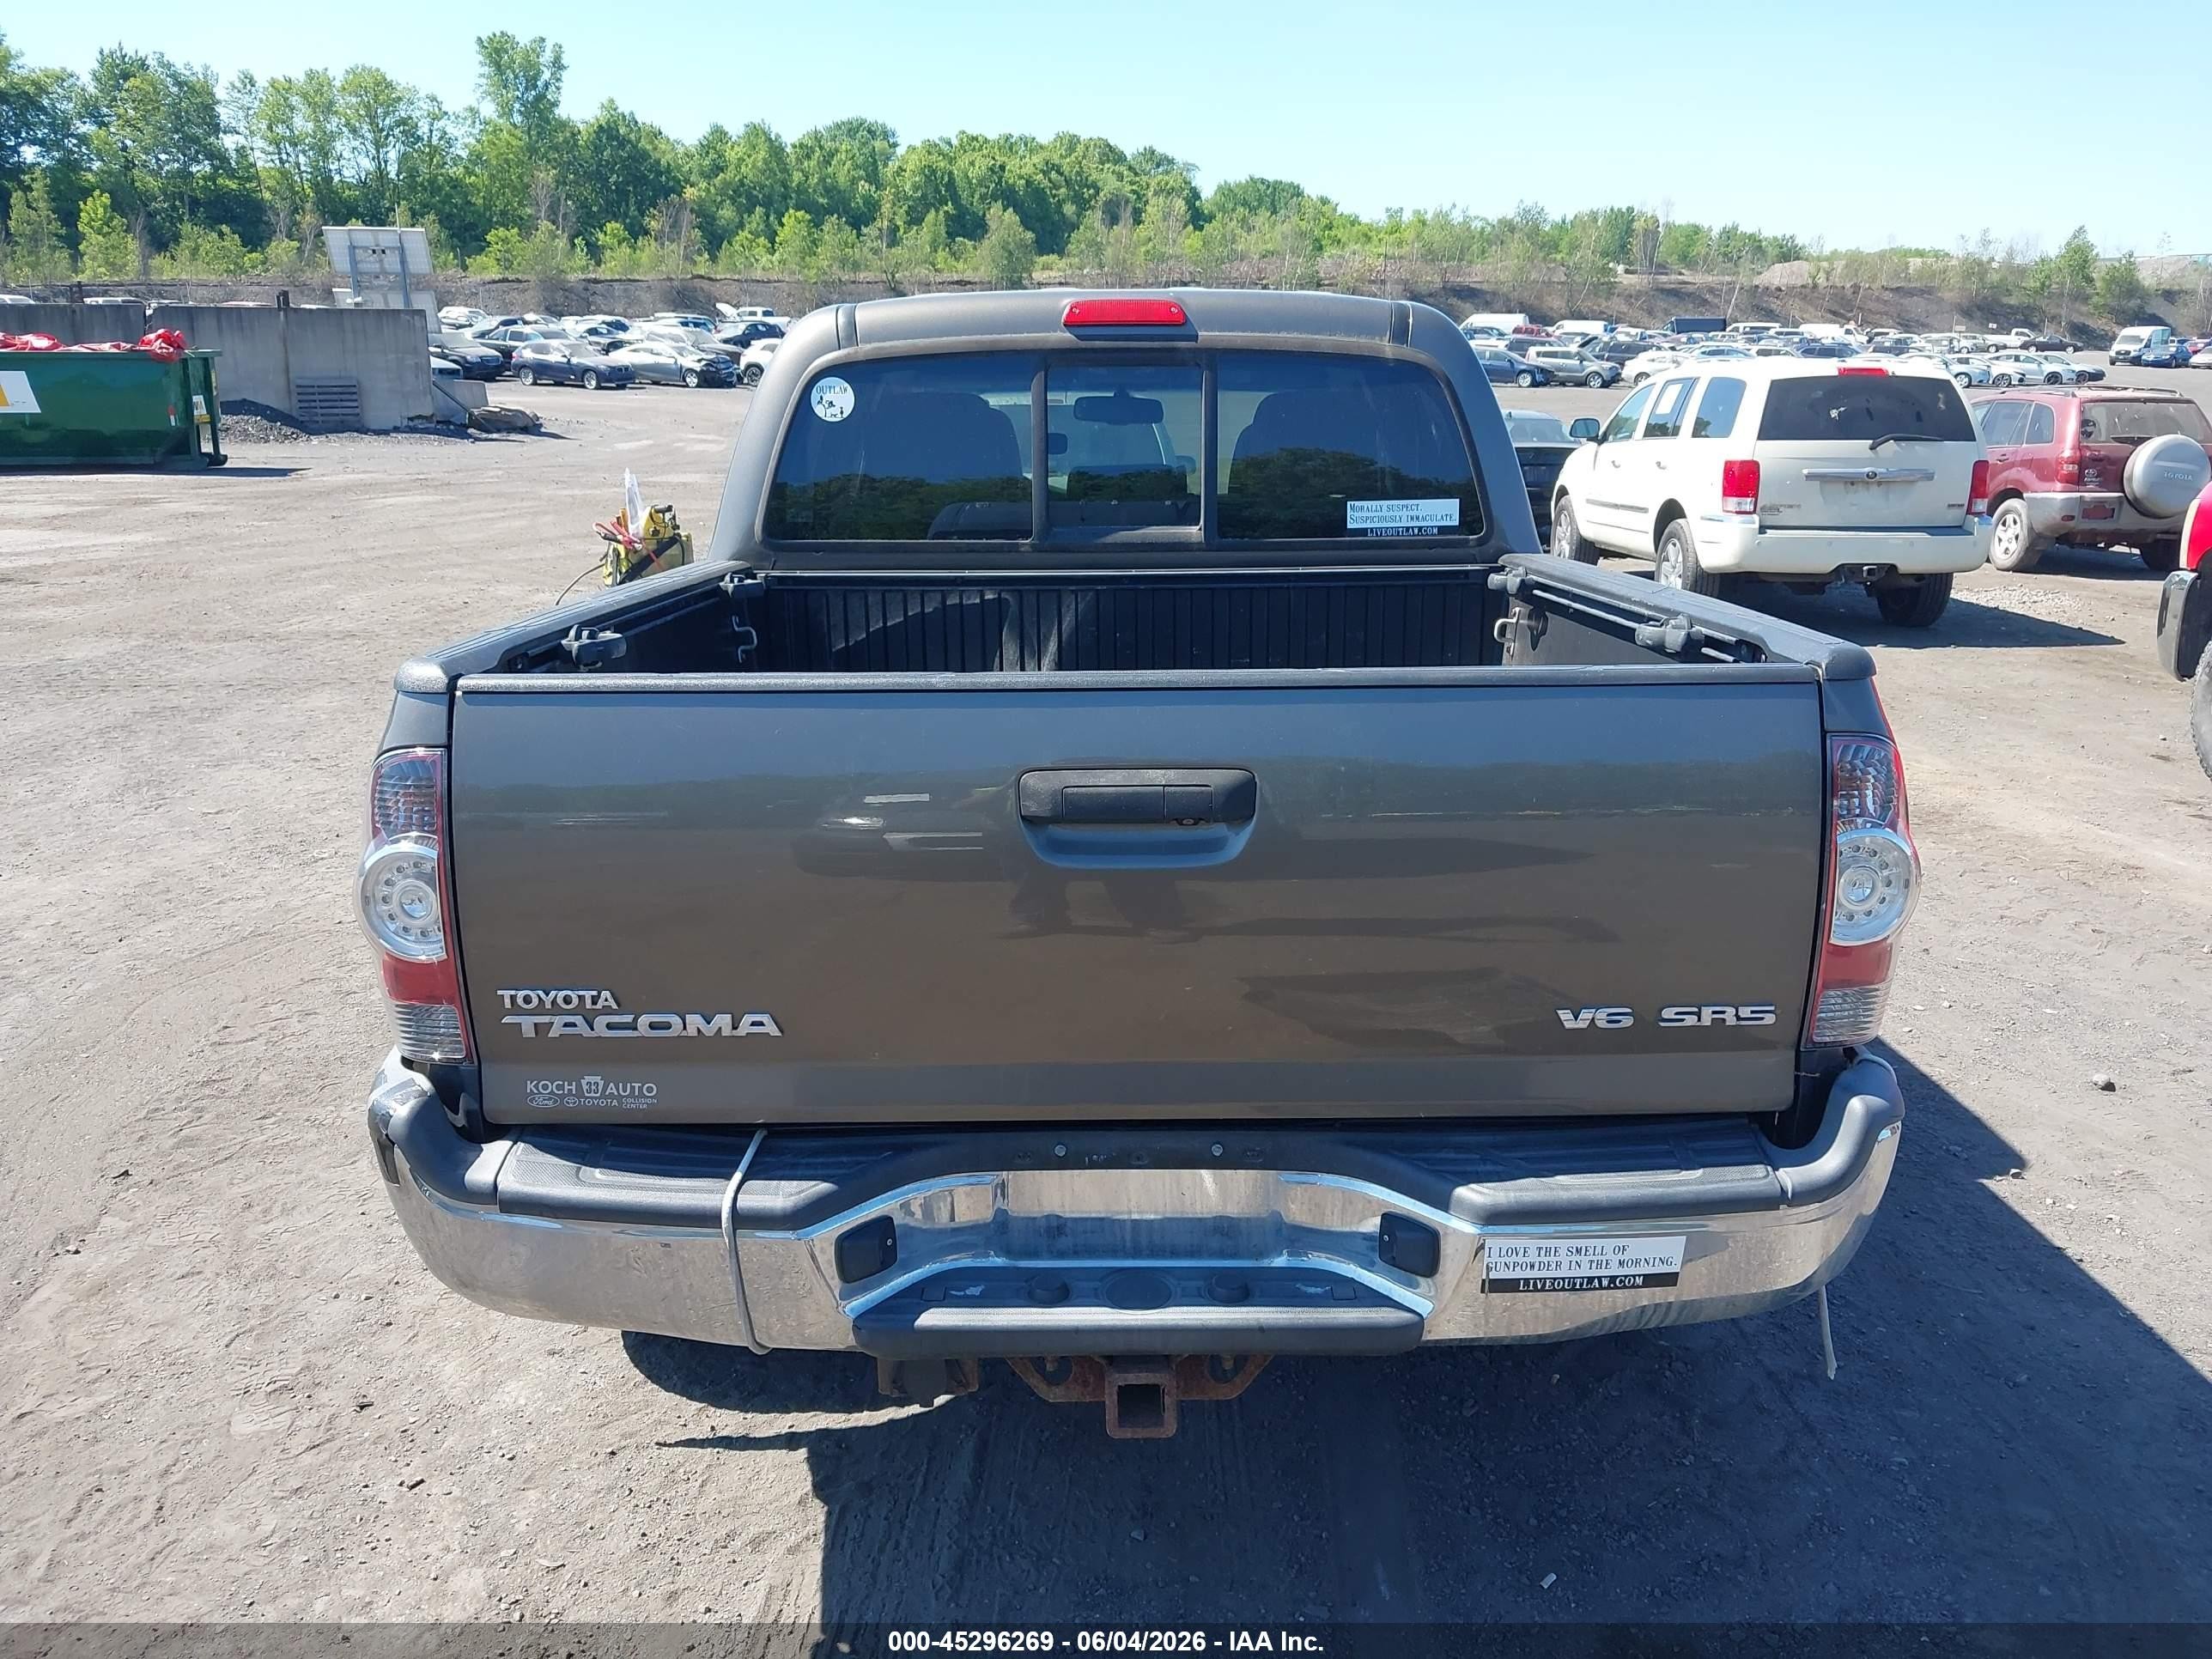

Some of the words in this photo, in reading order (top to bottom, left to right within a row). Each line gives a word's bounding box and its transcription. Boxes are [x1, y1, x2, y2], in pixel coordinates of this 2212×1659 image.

[816, 384, 848, 395] OUTLAW
[2163, 471, 2193, 481] TOYOTA
[1367, 526, 1438, 537] LIVEOUTLAW.COM
[496, 990, 618, 1010] TOYOTA
[1555, 1006, 1635, 1030] V6
[1657, 1005, 1777, 1027] SR5
[501, 1013, 783, 1038] TACOMA
[526, 1080, 576, 1094] KOCH
[586, 1081, 600, 1095] 33
[605, 1083, 657, 1097] AUTO
[580, 1098, 619, 1107] TOYOTA
[1487, 1247, 1493, 1258] I
[1498, 1247, 1530, 1258] LOVE
[1536, 1246, 1561, 1257] THE
[1565, 1245, 1608, 1257] SMELL
[1613, 1244, 1630, 1255] OF
[1486, 1261, 1563, 1273] GUNPOWDER
[1568, 1260, 1582, 1271] IN
[1588, 1259, 1613, 1270] THE
[1617, 1256, 1678, 1269] MORNING.
[1519, 1276, 1644, 1291] LIVEOUTLAW.COM
